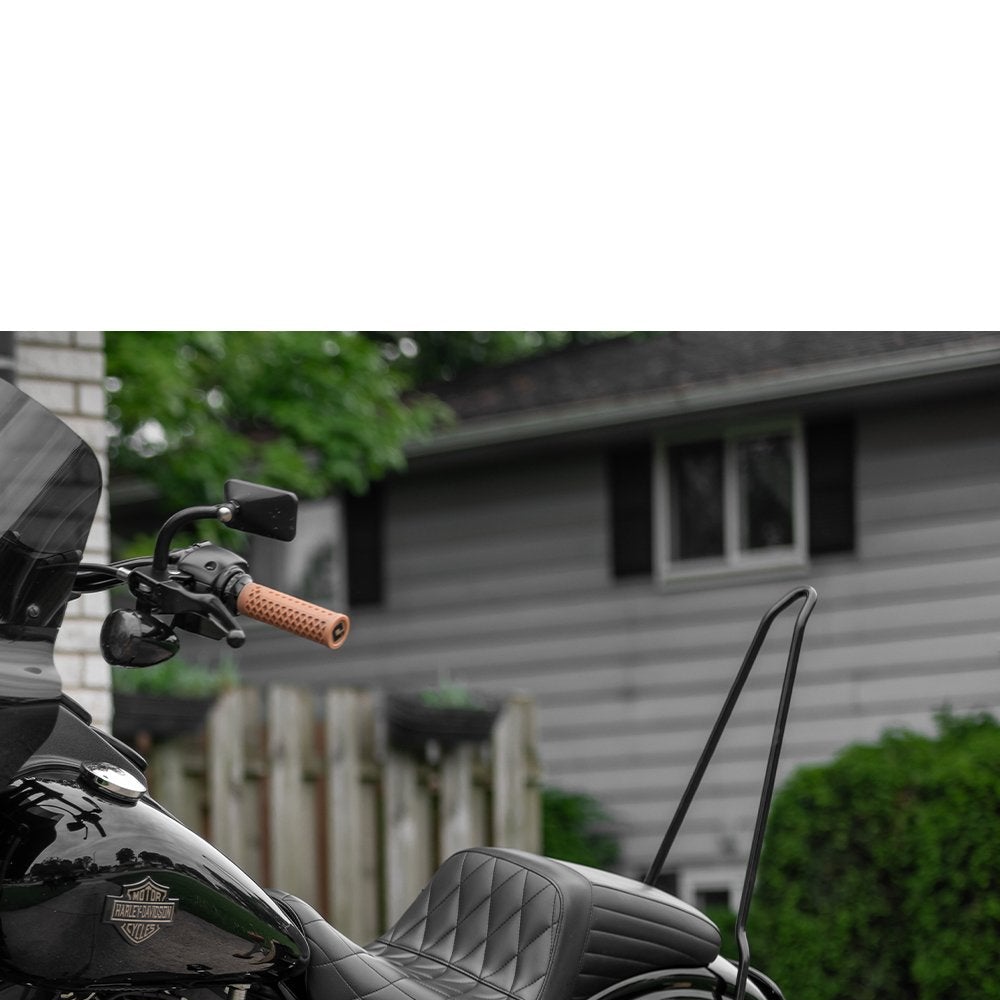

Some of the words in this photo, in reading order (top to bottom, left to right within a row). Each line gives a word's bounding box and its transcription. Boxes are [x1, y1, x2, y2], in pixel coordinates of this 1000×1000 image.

[133, 885, 162, 901] MOTOR
[115, 903, 173, 918] HARLEY-DAVIDSON
[126, 923, 156, 940] CYCLES
